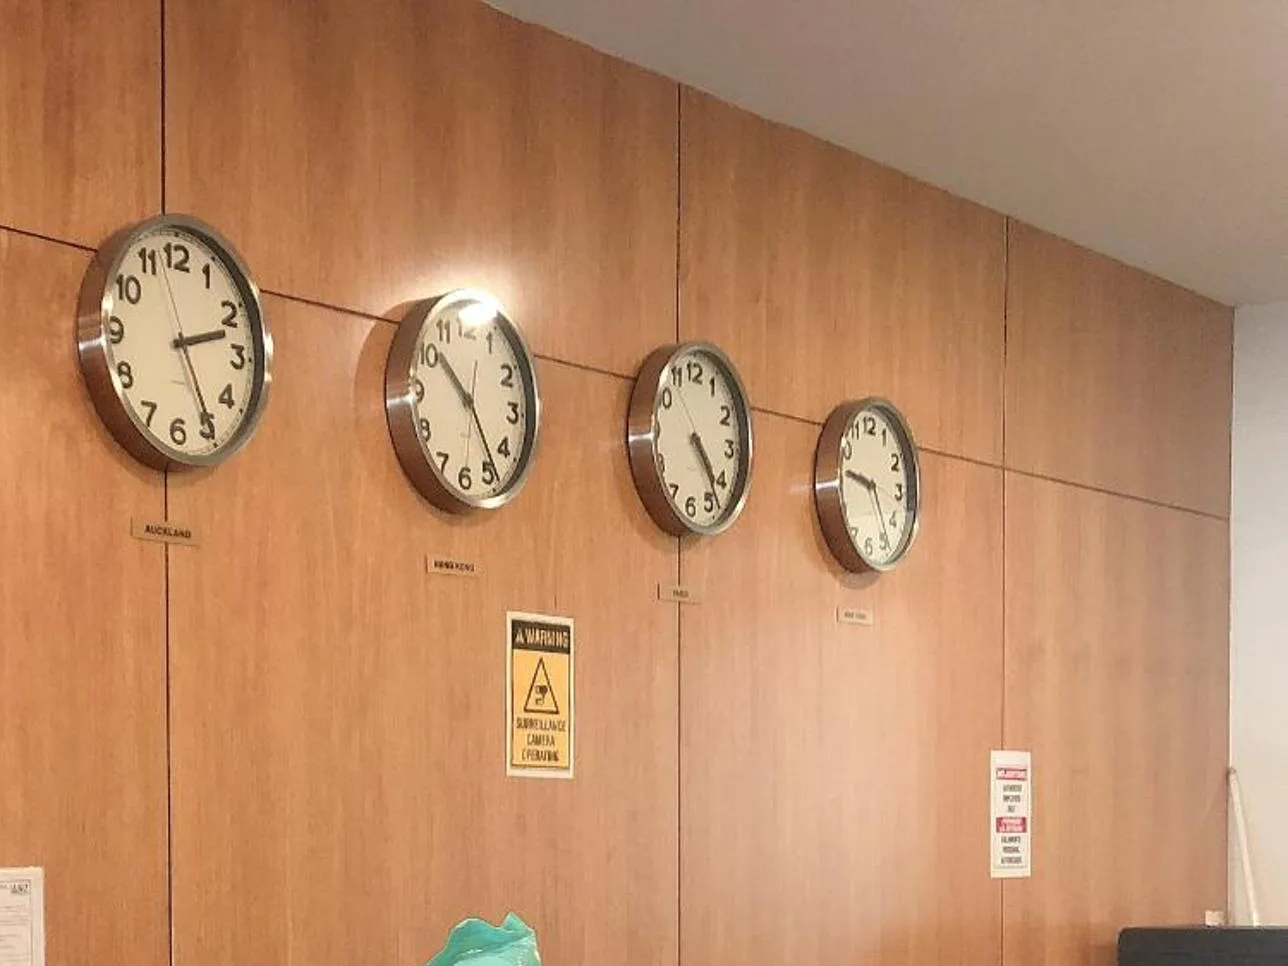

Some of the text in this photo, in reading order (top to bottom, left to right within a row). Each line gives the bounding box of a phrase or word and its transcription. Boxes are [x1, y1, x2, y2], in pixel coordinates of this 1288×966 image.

[138, 248, 157, 275] 11
[163, 242, 190, 273] 12
[202, 263, 211, 289] 1
[116, 274, 141, 304] 10
[221, 301, 238, 328] 2
[110, 316, 124, 344] 9
[436, 319, 450, 344] 11
[486, 331, 494, 355] 1
[230, 343, 245, 370] 3
[420, 343, 439, 368] 10
[117, 361, 134, 389] 8
[500, 364, 514, 388] 2
[671, 365, 683, 388] 11
[686, 361, 704, 385] 12
[218, 383, 234, 409] 4
[414, 379, 425, 403] 9
[710, 376, 716, 397] 1
[141, 400, 157, 427] 7
[506, 401, 520, 425] 3
[720, 406, 730, 426] 2
[170, 418, 186, 445] 6
[420, 418, 432, 443] 8
[862, 416, 876, 436] 12
[497, 436, 511, 458] 4
[724, 440, 734, 459] 3
[881, 429, 887, 447] 1
[436, 451, 449, 475] 7
[482, 461, 497, 485] 5
[891, 454, 900, 472] 2
[458, 467, 472, 490] 6
[716, 471, 726, 489] 4
[669, 483, 679, 502] 7
[703, 492, 713, 512] 5
[894, 484, 903, 501] 3
[685, 497, 696, 518] 6
[889, 510, 897, 527] 4
[144, 524, 191, 538] AUCKLAND
[879, 533, 888, 551] 5
[864, 537, 873, 556] 6
[525, 627, 568, 648] WARNING
[516, 717, 566, 733] SURVEILLANCE
[526, 733, 555, 747] CAMERA
[521, 749, 560, 762] OPERATING
